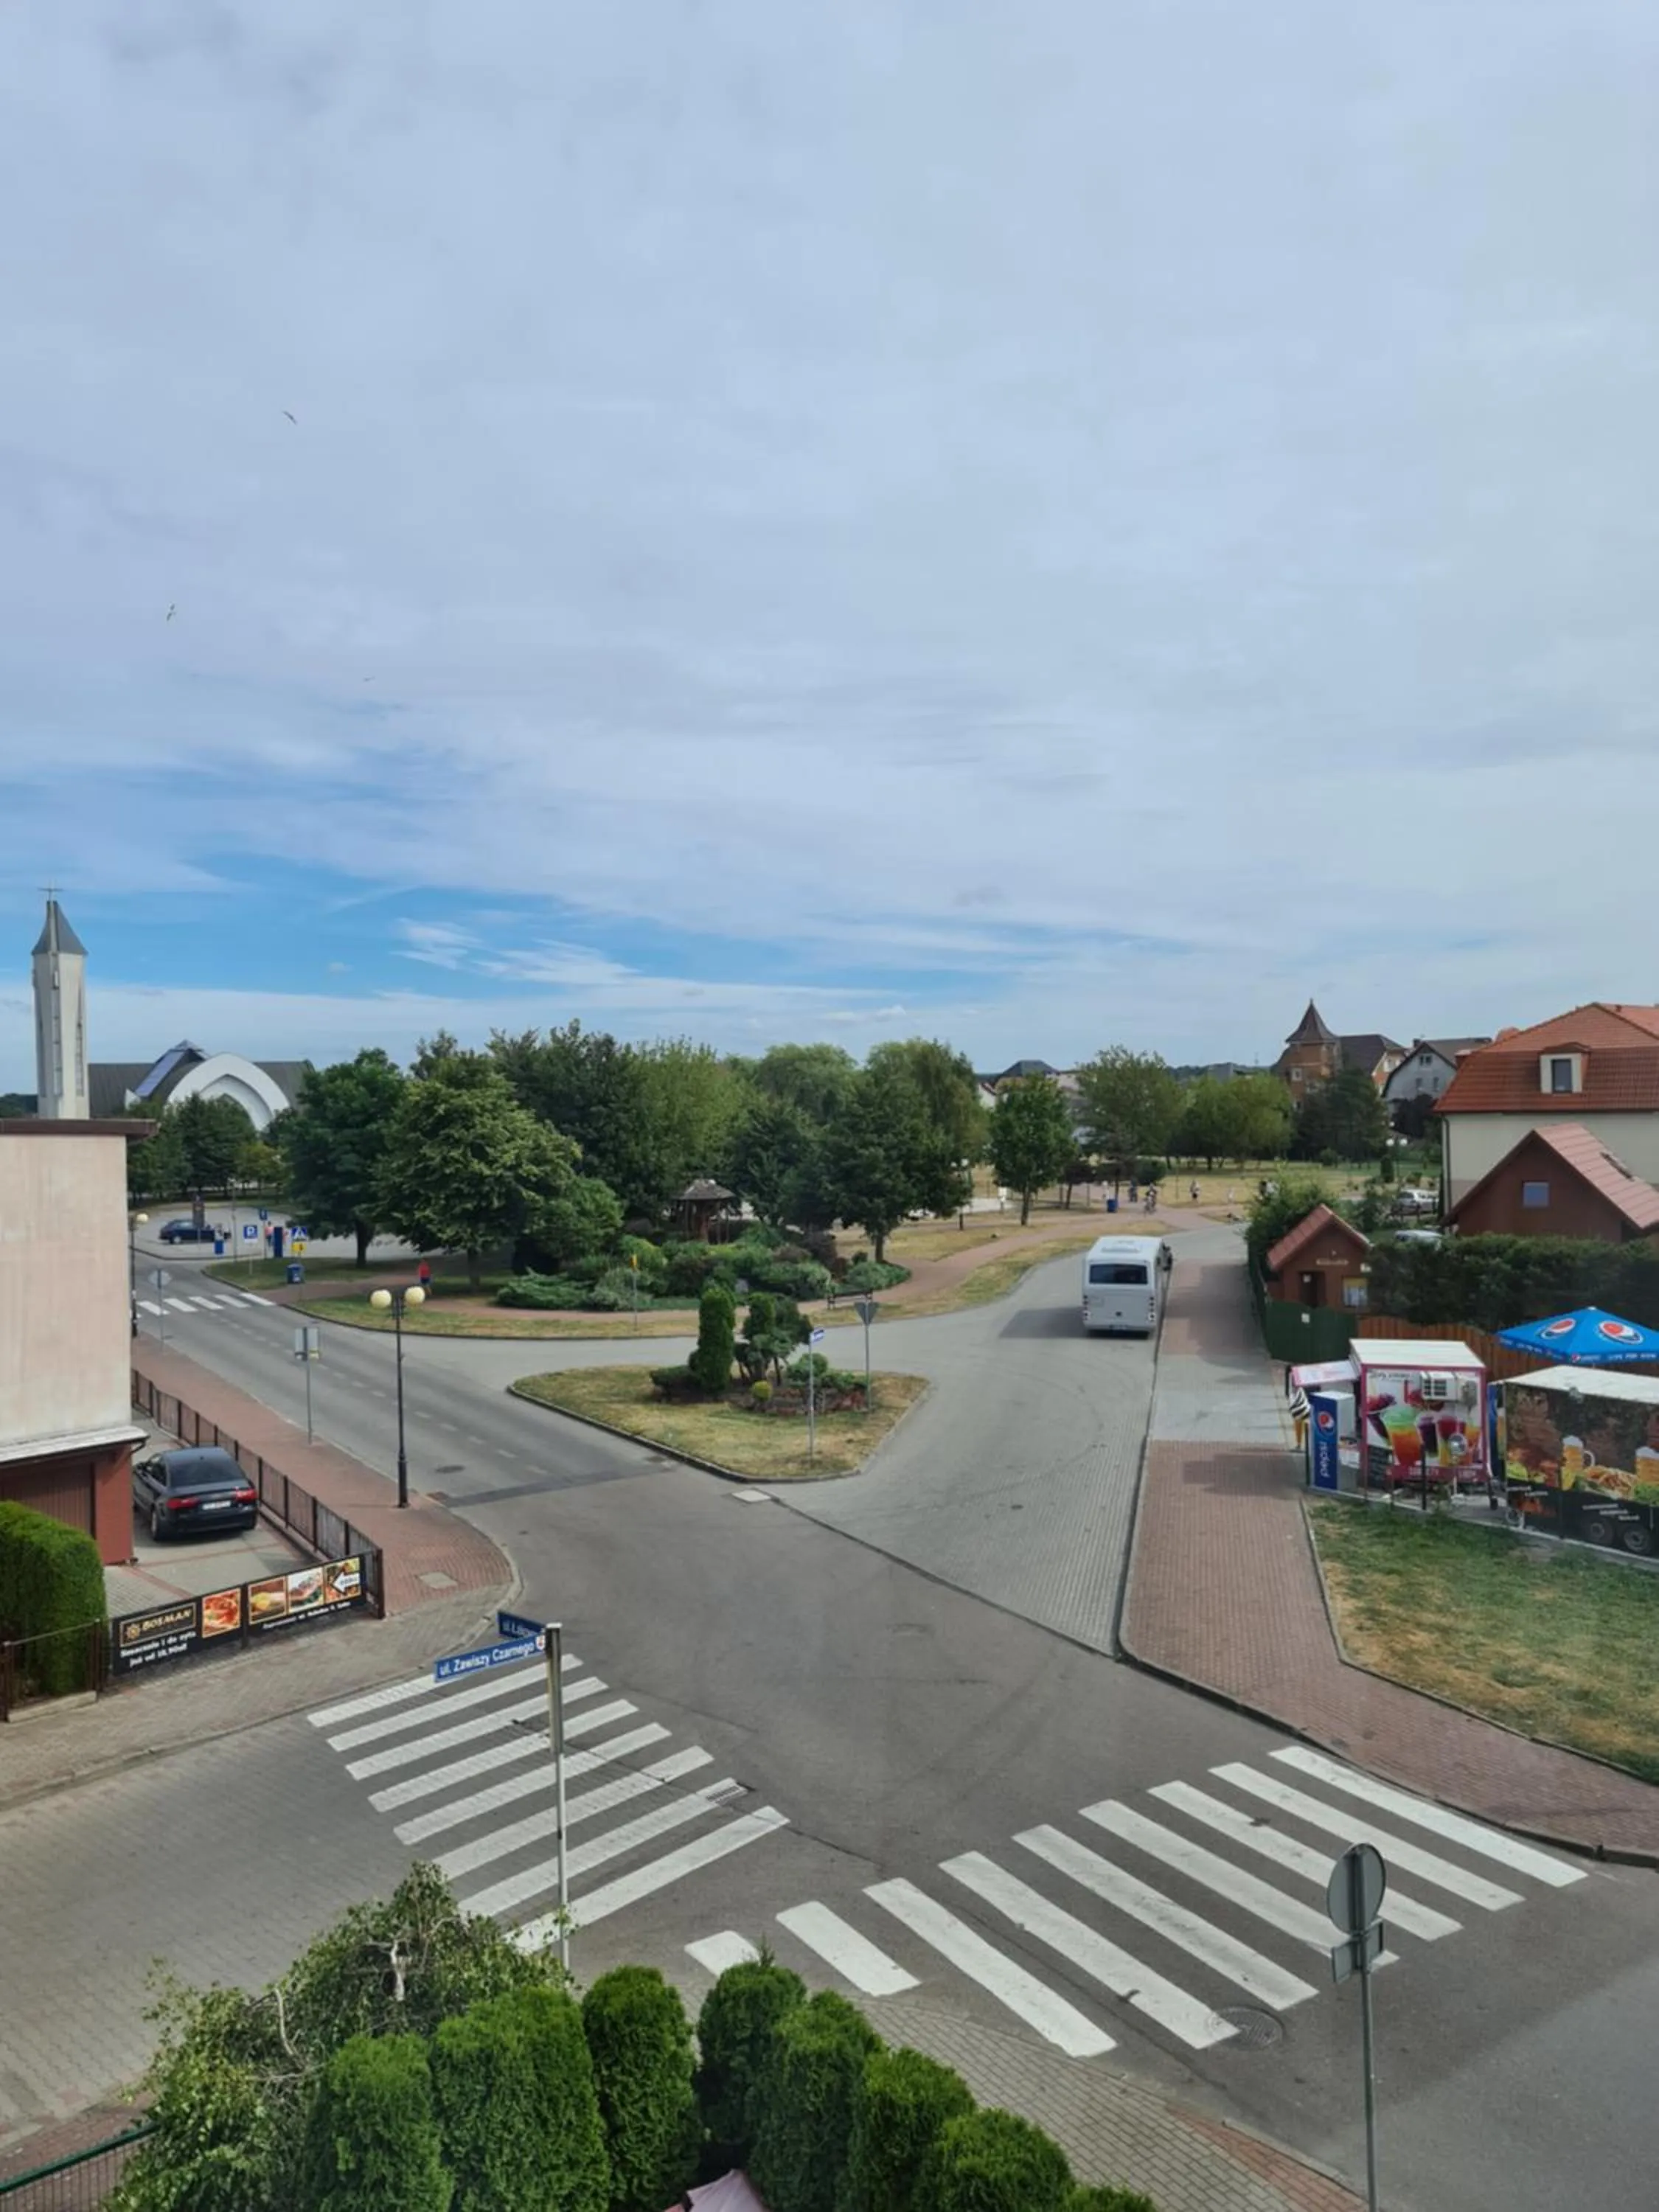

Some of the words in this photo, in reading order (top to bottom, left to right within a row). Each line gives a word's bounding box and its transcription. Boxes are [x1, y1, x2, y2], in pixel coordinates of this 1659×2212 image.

[1319, 1441, 1330, 1478] pepsi
[142, 1609, 192, 1631] BOSMAN
[439, 1661, 451, 1676] ul.
[453, 1654, 490, 1672] Zawiszy
[492, 1641, 535, 1662] Czarnego
